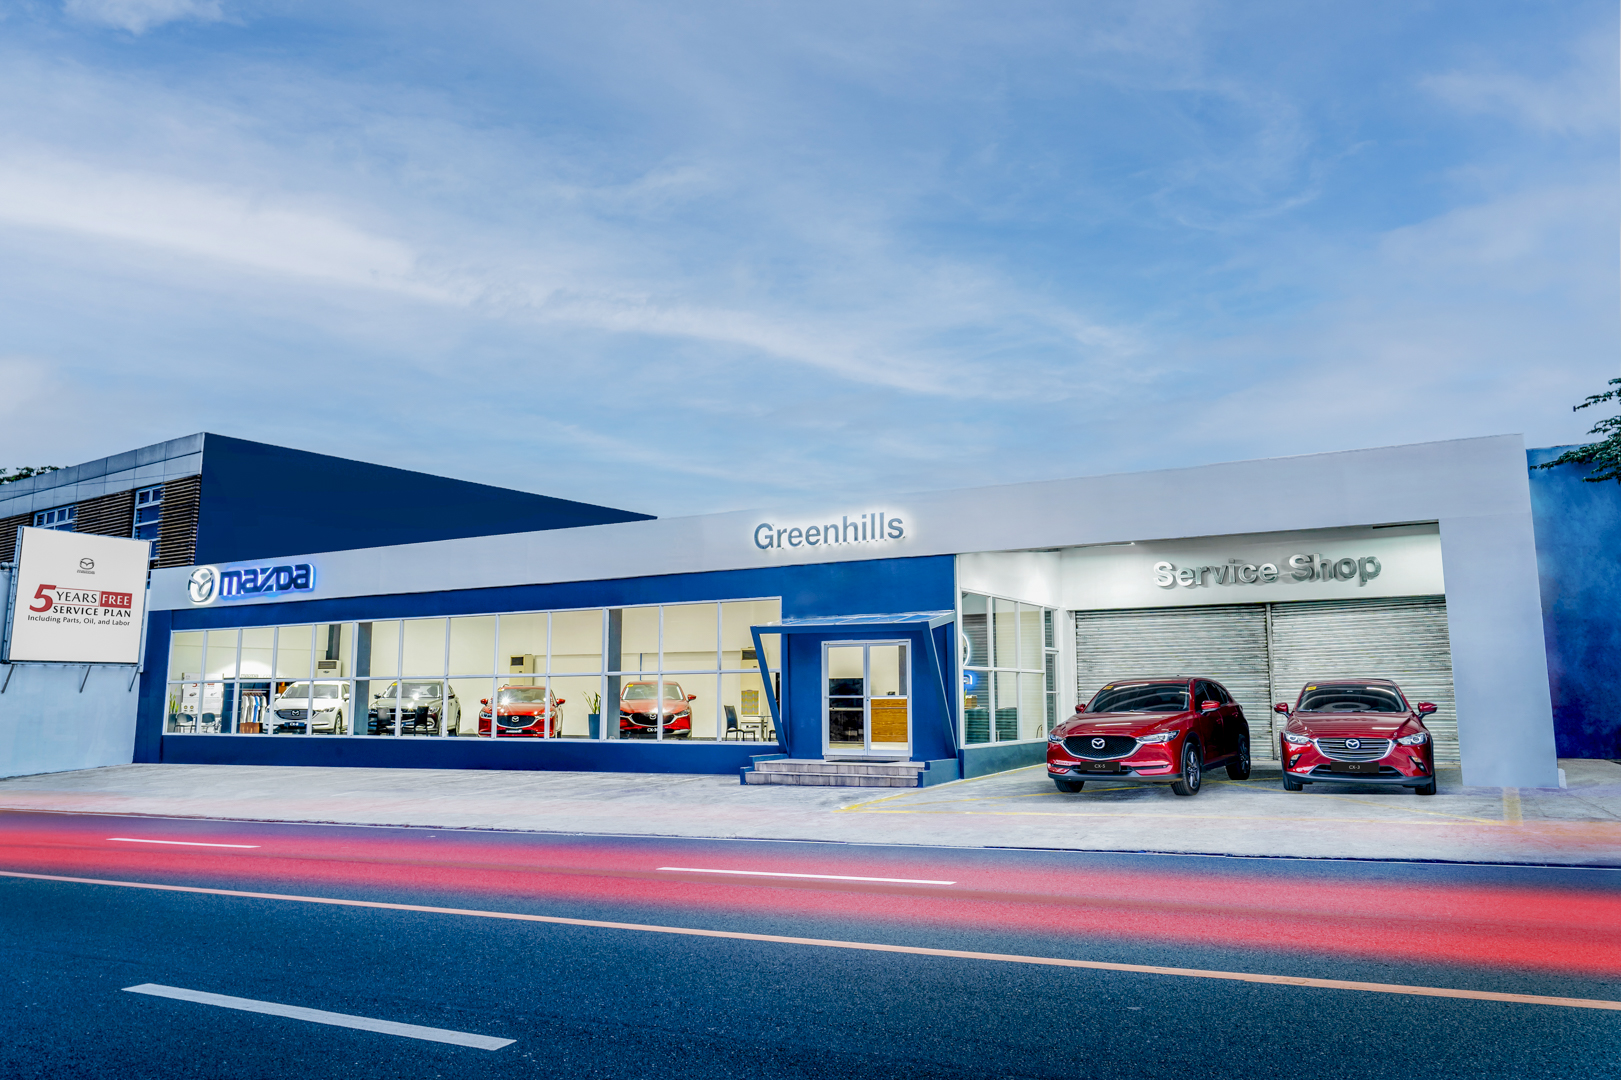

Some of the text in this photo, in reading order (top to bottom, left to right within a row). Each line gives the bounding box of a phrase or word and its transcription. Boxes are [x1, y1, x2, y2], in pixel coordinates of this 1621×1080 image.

[754, 512, 904, 550] Greenhills
[1153, 553, 1382, 587] Service Shop
[29, 584, 130, 612] 5 YEARS FREE
[52, 605, 132, 618] SERVICE PLAN
[27, 614, 61, 624] Including
[62, 616, 81, 625] Parts,
[83, 617, 96, 625] Oil,
